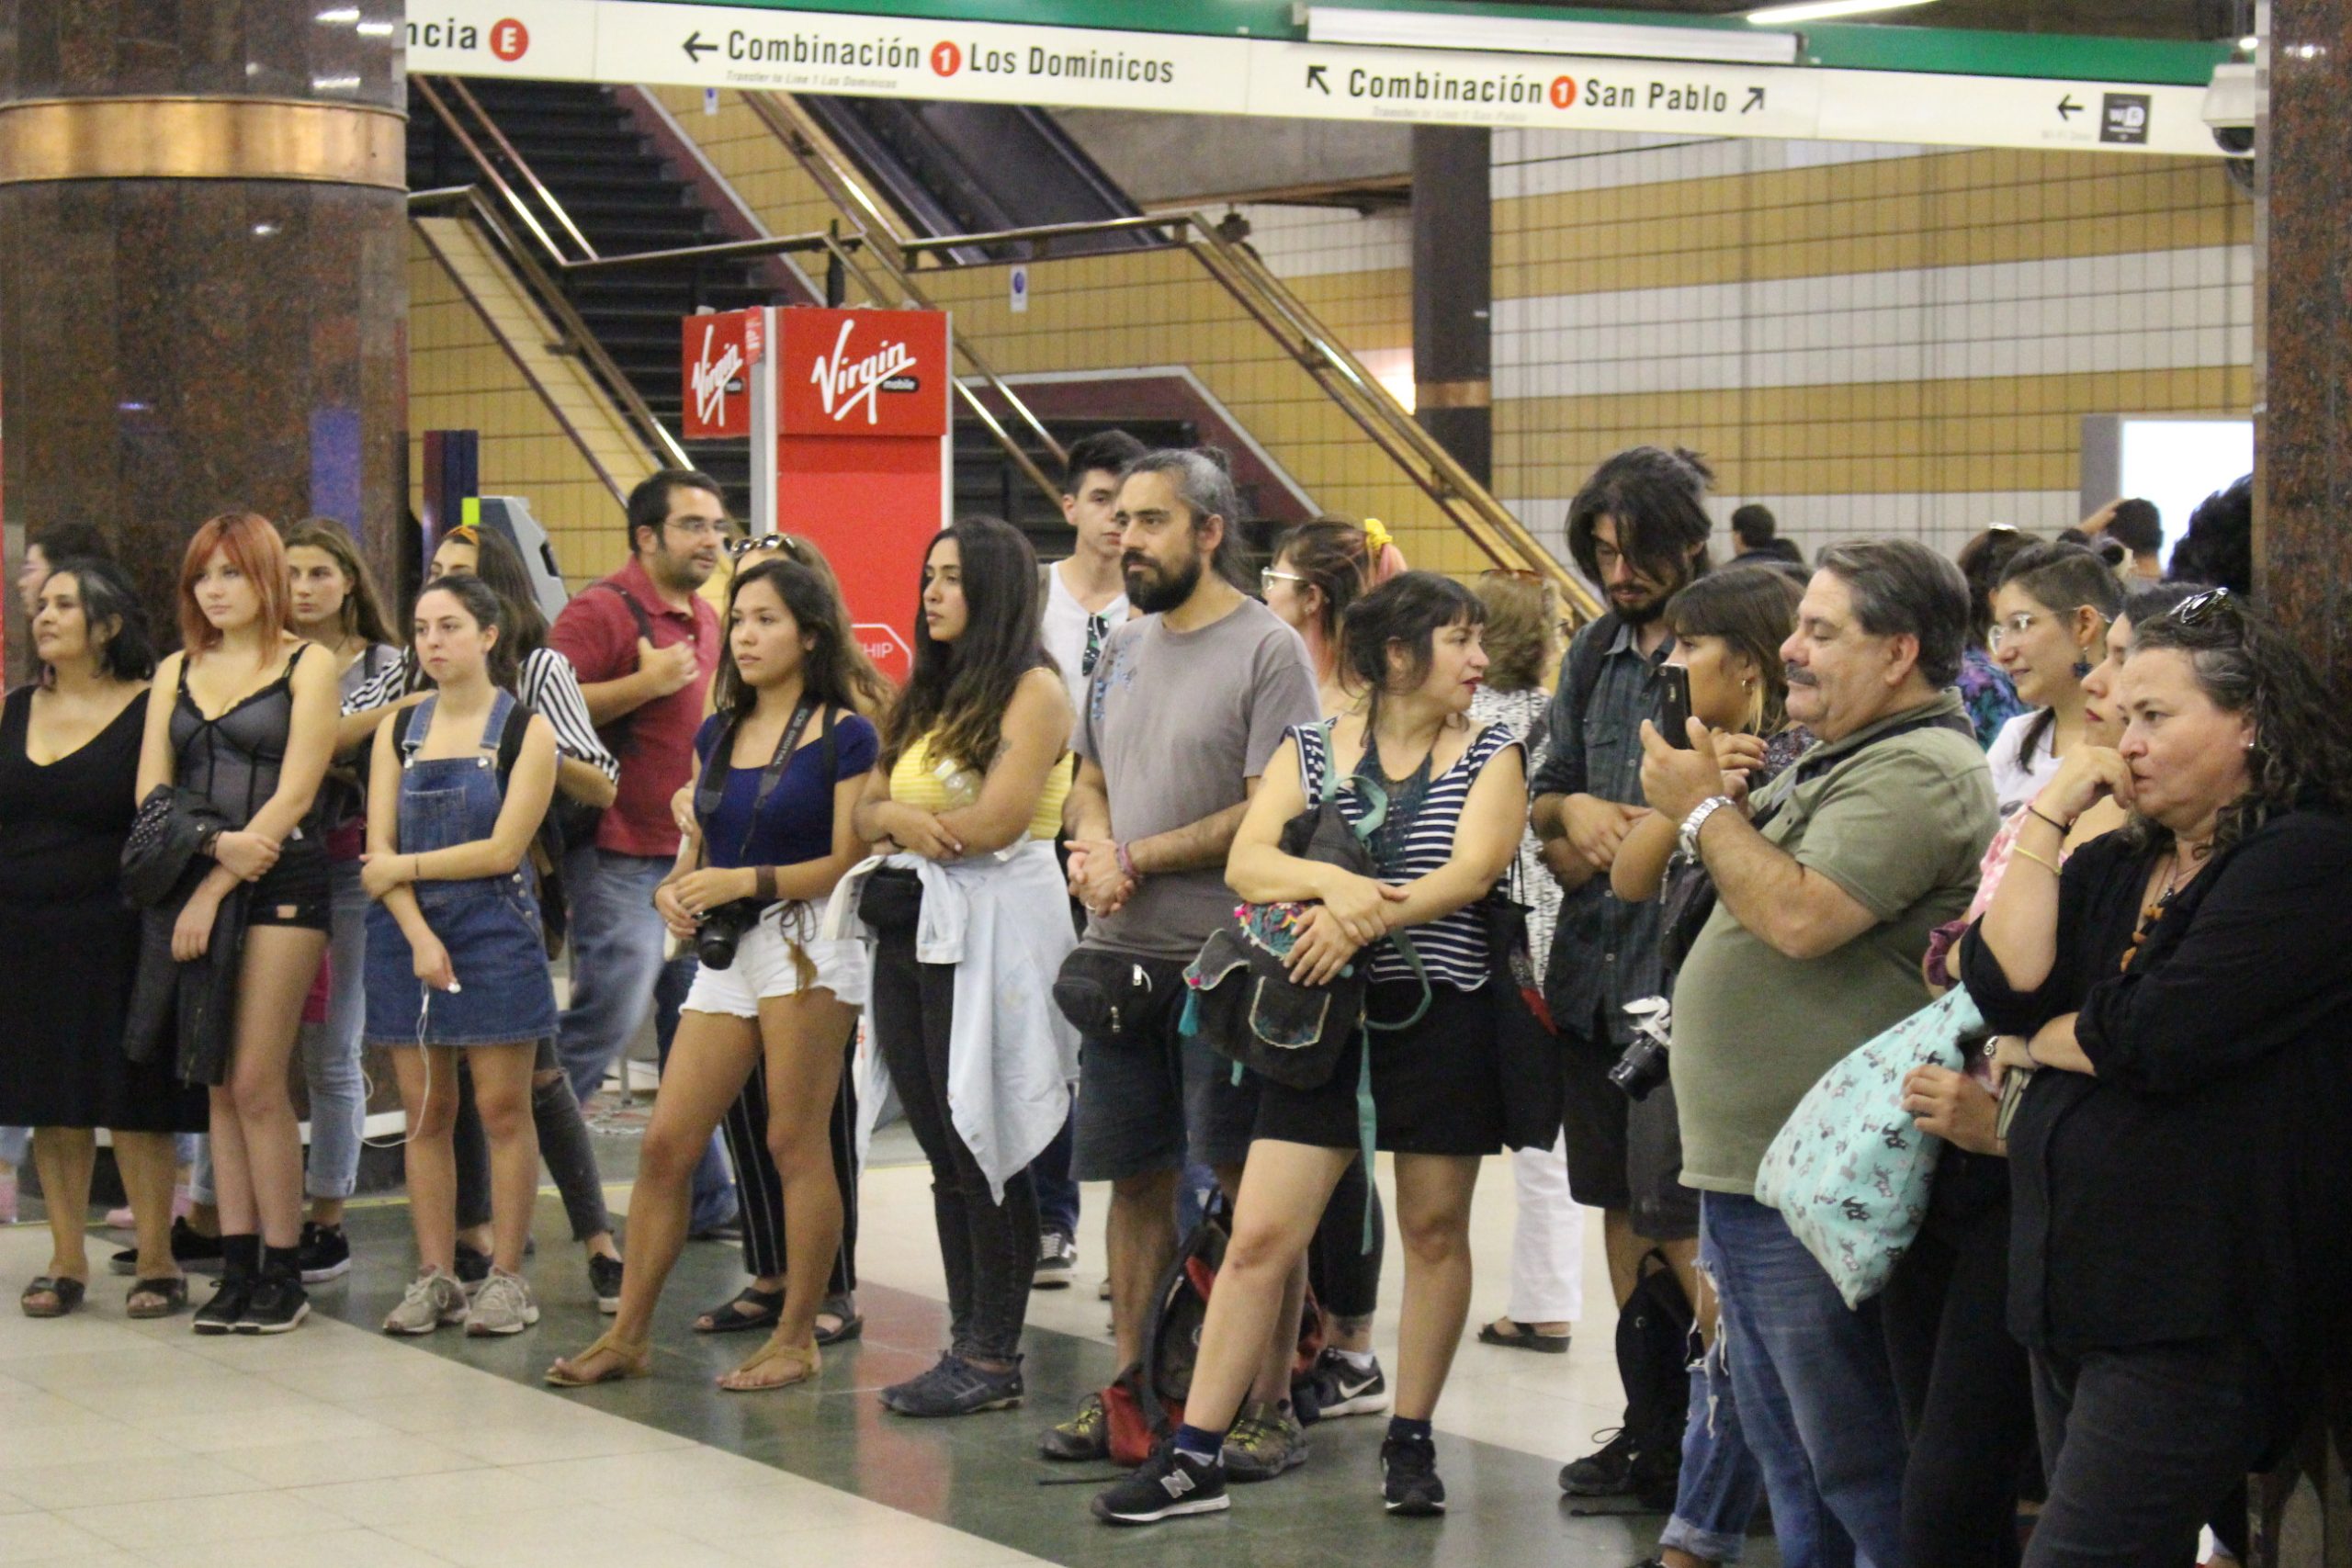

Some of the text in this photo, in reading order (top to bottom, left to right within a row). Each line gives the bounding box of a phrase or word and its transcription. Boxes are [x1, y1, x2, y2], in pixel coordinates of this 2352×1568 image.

[405, 17, 478, 50] ncia
[728, 29, 920, 69] Combinación
[969, 42, 1017, 74] Los
[1027, 46, 1175, 84] Dominicos
[1348, 68, 1544, 104] Combinación
[1584, 78, 1635, 109] San
[1648, 82, 1728, 113] Pablo
[810, 318, 917, 425] Virgin
[881, 378, 916, 390] mobile
